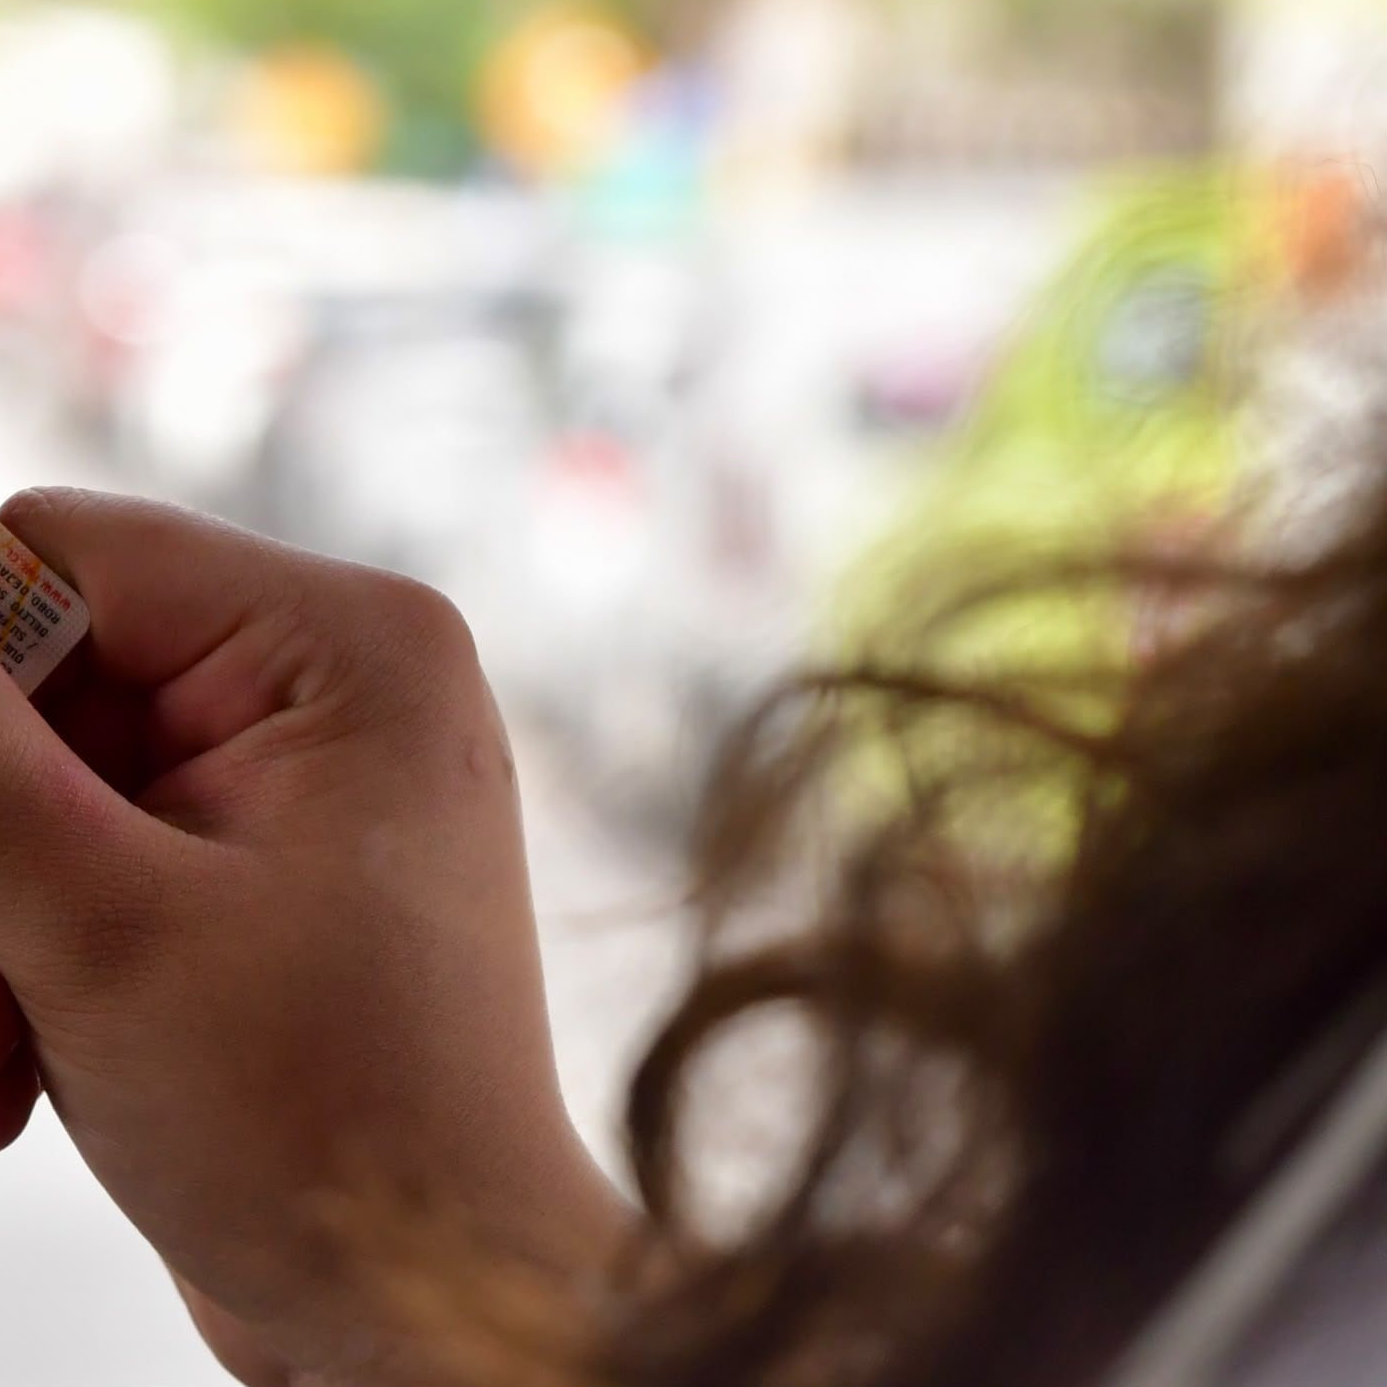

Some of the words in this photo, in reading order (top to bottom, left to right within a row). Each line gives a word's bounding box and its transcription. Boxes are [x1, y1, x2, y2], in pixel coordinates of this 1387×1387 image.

[9, 600, 48, 638] DELITO
[9, 624, 26, 641] SU
[2, 641, 24, 663] QUE
